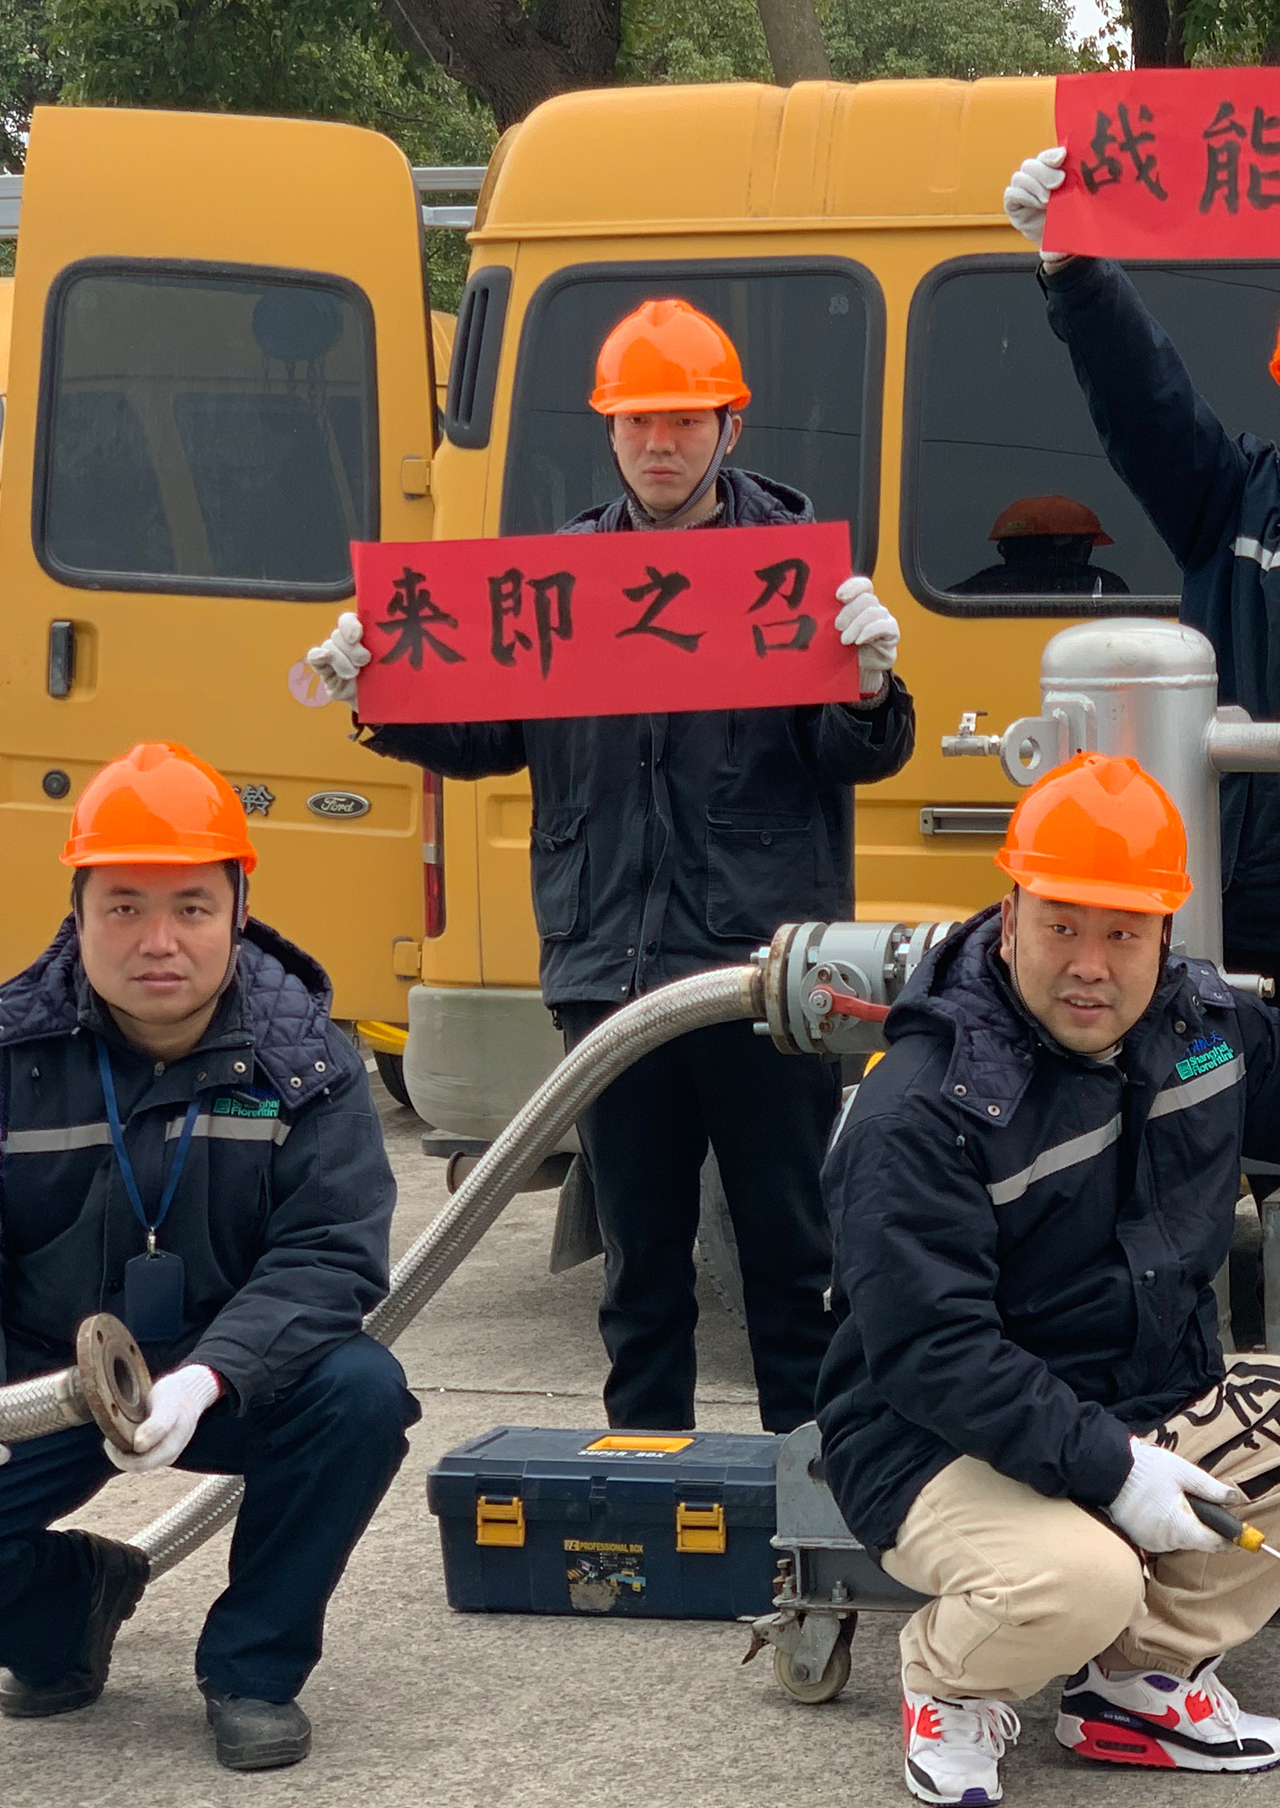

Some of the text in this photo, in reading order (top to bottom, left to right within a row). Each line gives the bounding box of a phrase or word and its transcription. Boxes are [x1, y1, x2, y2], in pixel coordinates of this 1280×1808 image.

[320, 797, 354, 813] Ford
[1189, 1041, 1230, 1066] Shanghai
[579, 1542, 629, 1553] PROFESSIONAL
[629, 1544, 644, 1553] BOX
